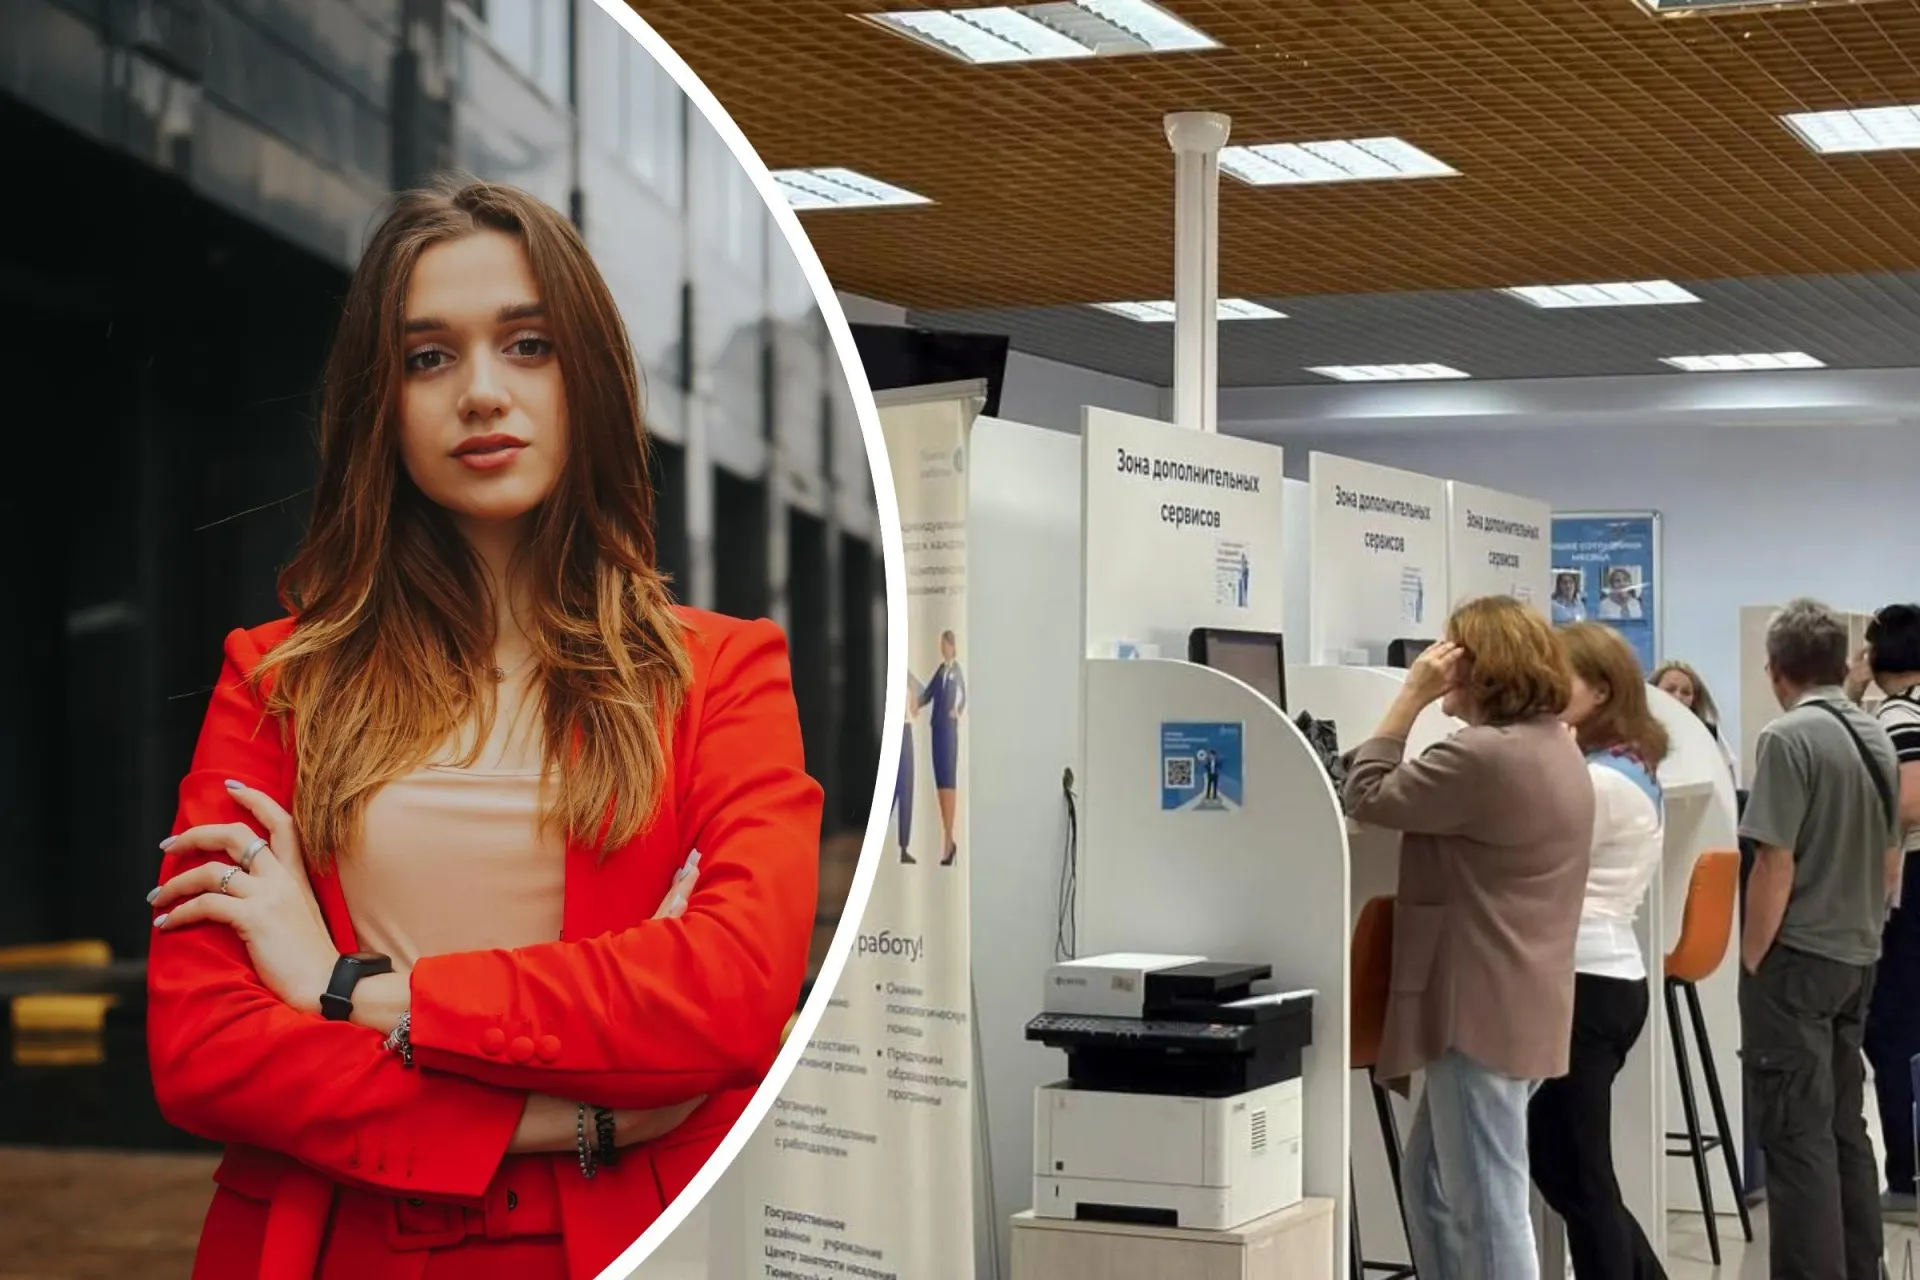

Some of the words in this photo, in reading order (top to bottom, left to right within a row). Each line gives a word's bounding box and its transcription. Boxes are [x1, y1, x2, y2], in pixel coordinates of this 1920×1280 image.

[1117, 448, 1150, 475] Зона
[1153, 459, 1260, 492] дополнительных
[1161, 503, 1221, 529] сервисов
[1336, 485, 1357, 508] Зона
[1359, 494, 1430, 520] дополнительных
[1364, 532, 1404, 553] сервисов
[858, 930, 923, 962] работу!
